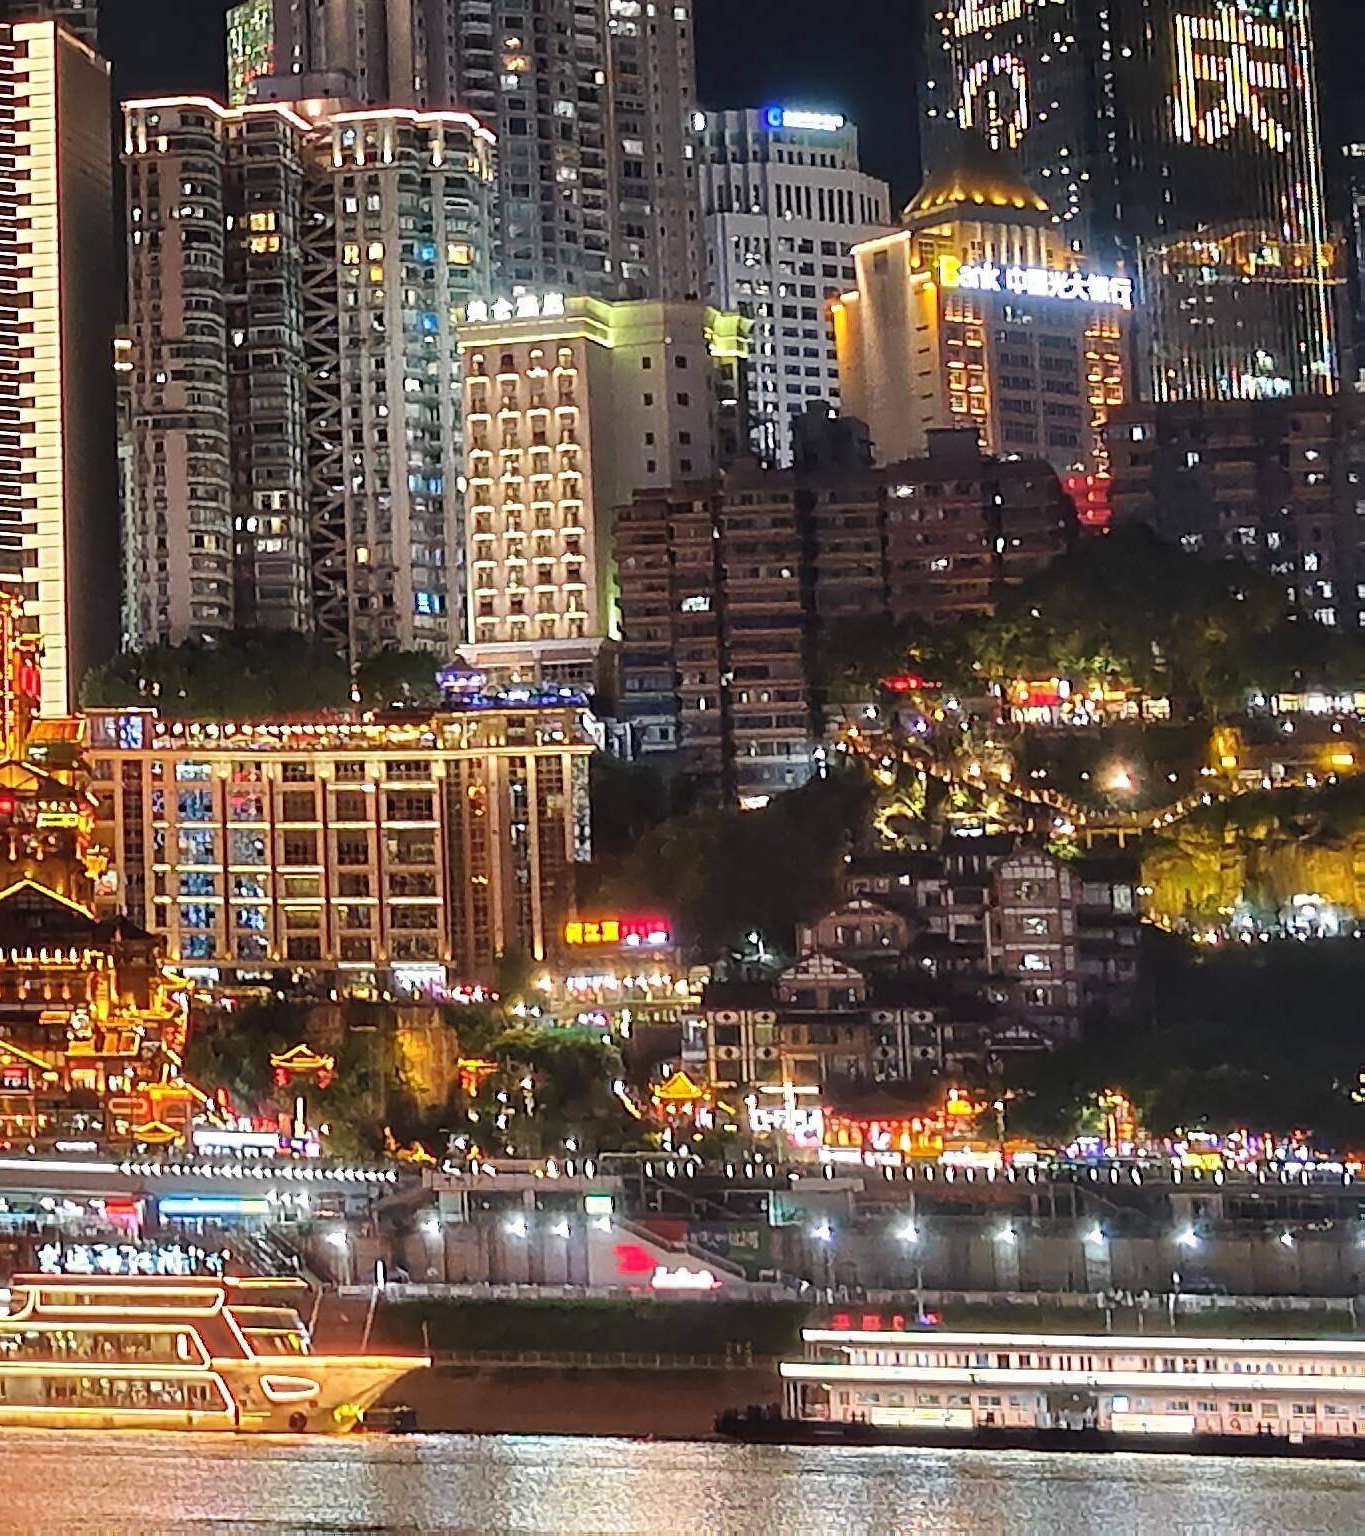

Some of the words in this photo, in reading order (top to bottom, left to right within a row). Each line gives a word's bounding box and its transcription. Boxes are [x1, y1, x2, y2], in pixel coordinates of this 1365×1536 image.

[1006, 266, 1133, 310] 中国光大银行
